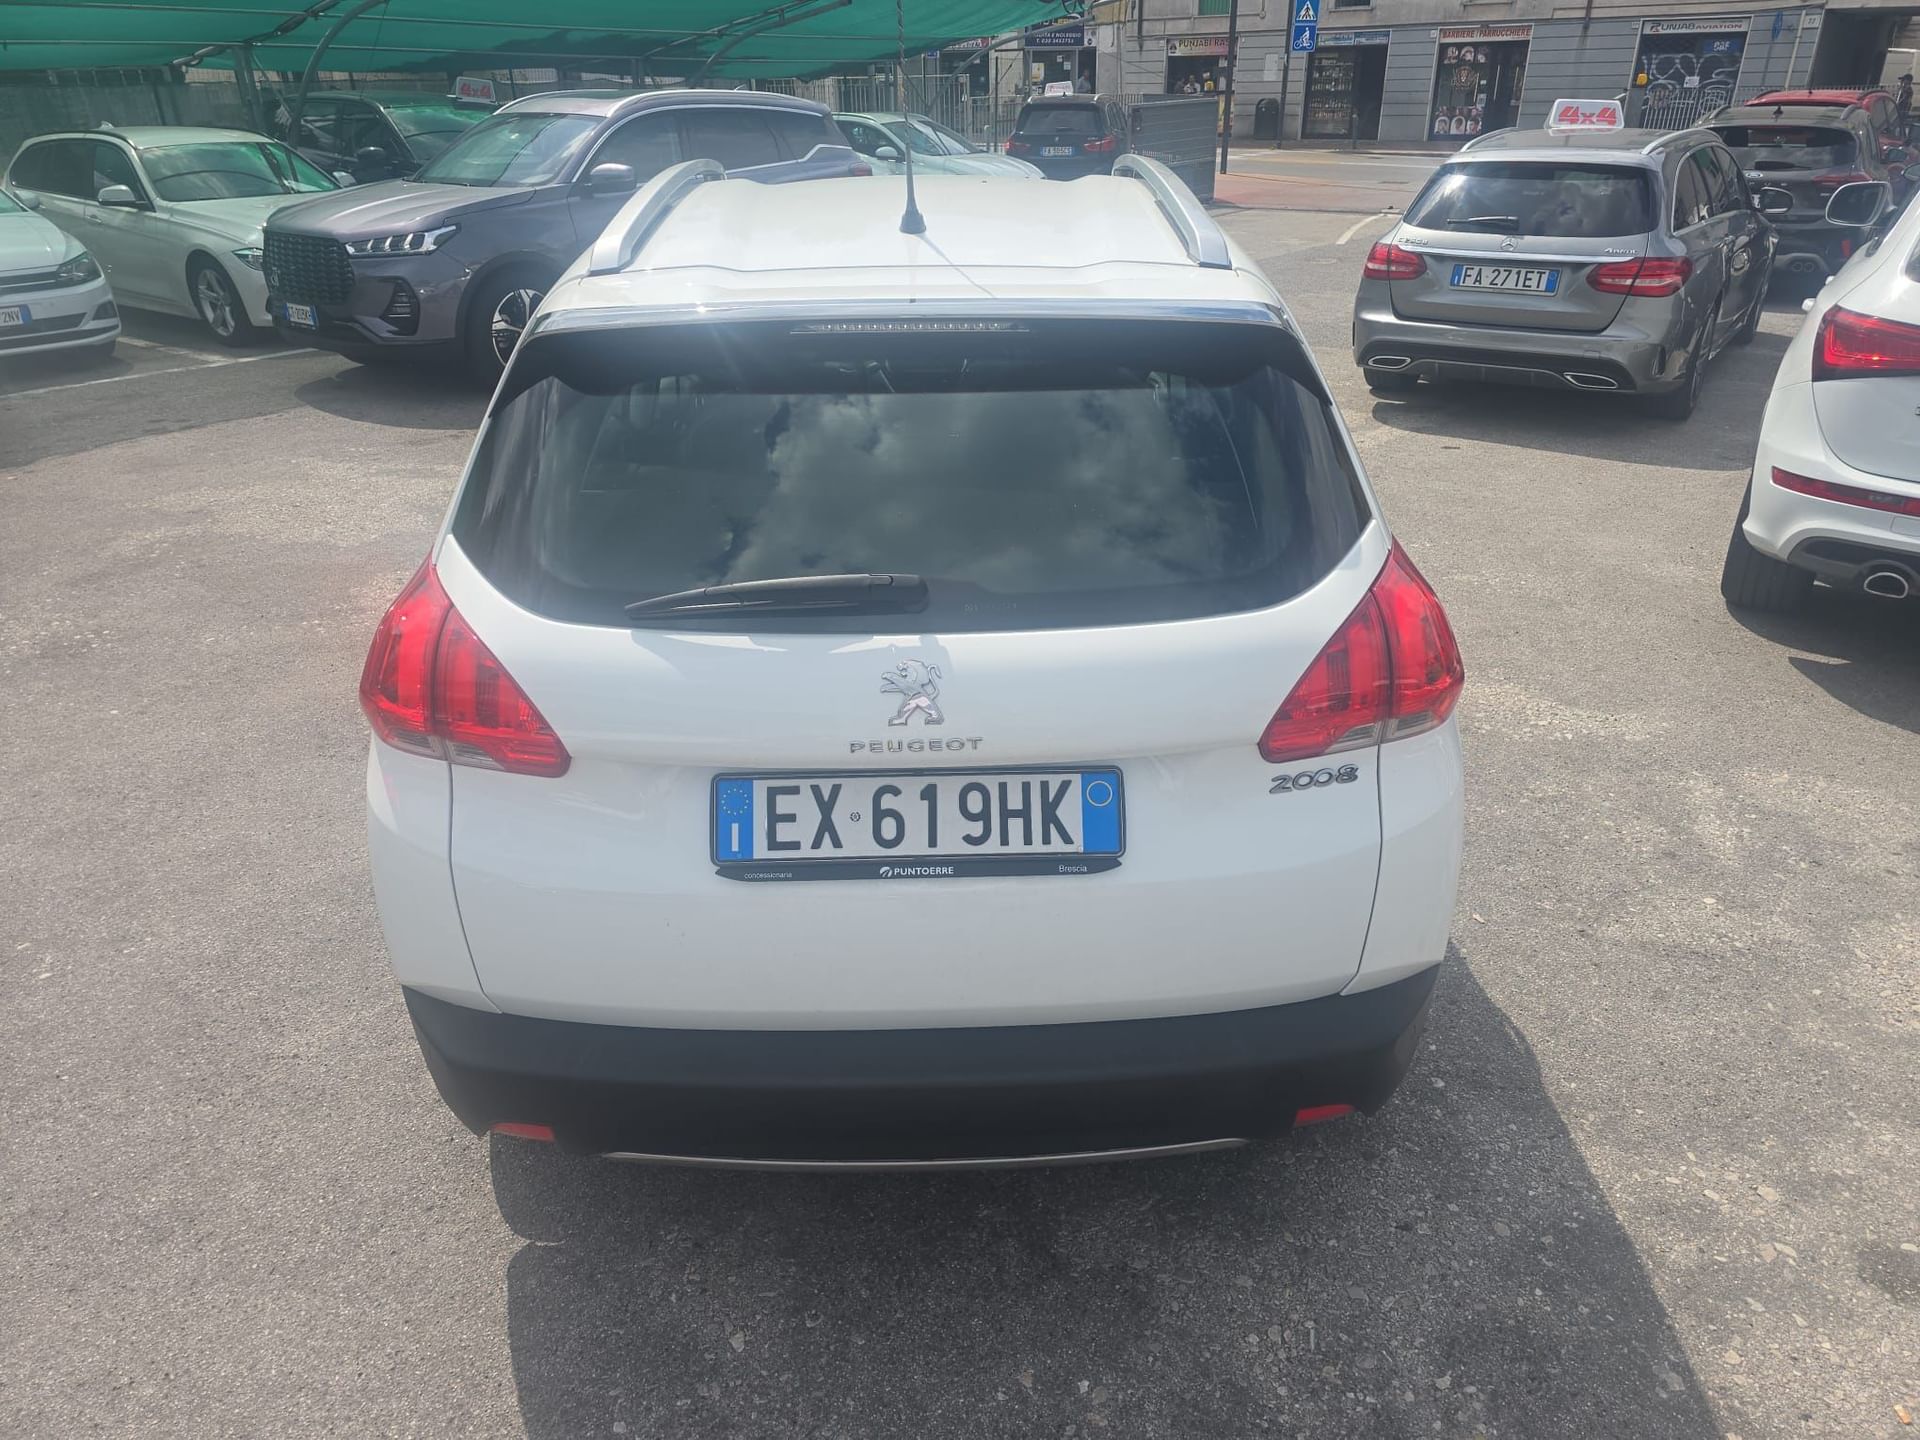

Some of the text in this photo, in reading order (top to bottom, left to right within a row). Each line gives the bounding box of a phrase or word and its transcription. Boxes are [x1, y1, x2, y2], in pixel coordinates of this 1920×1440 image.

[1442, 29, 1475, 39] BARBIERE
[1480, 27, 1531, 38] PARRUCCHIERE
[1178, 38, 1212, 49] PUNJABI
[1462, 267, 1482, 285] FA
[1489, 268, 1546, 289] 271ET
[850, 736, 984, 753] PEUGEOT
[1269, 763, 1359, 794] 2008
[766, 783, 844, 851] EX
[872, 779, 1075, 850] 619HK
[744, 864, 1088, 880] concessionaria PUNTOERRE Brescia
